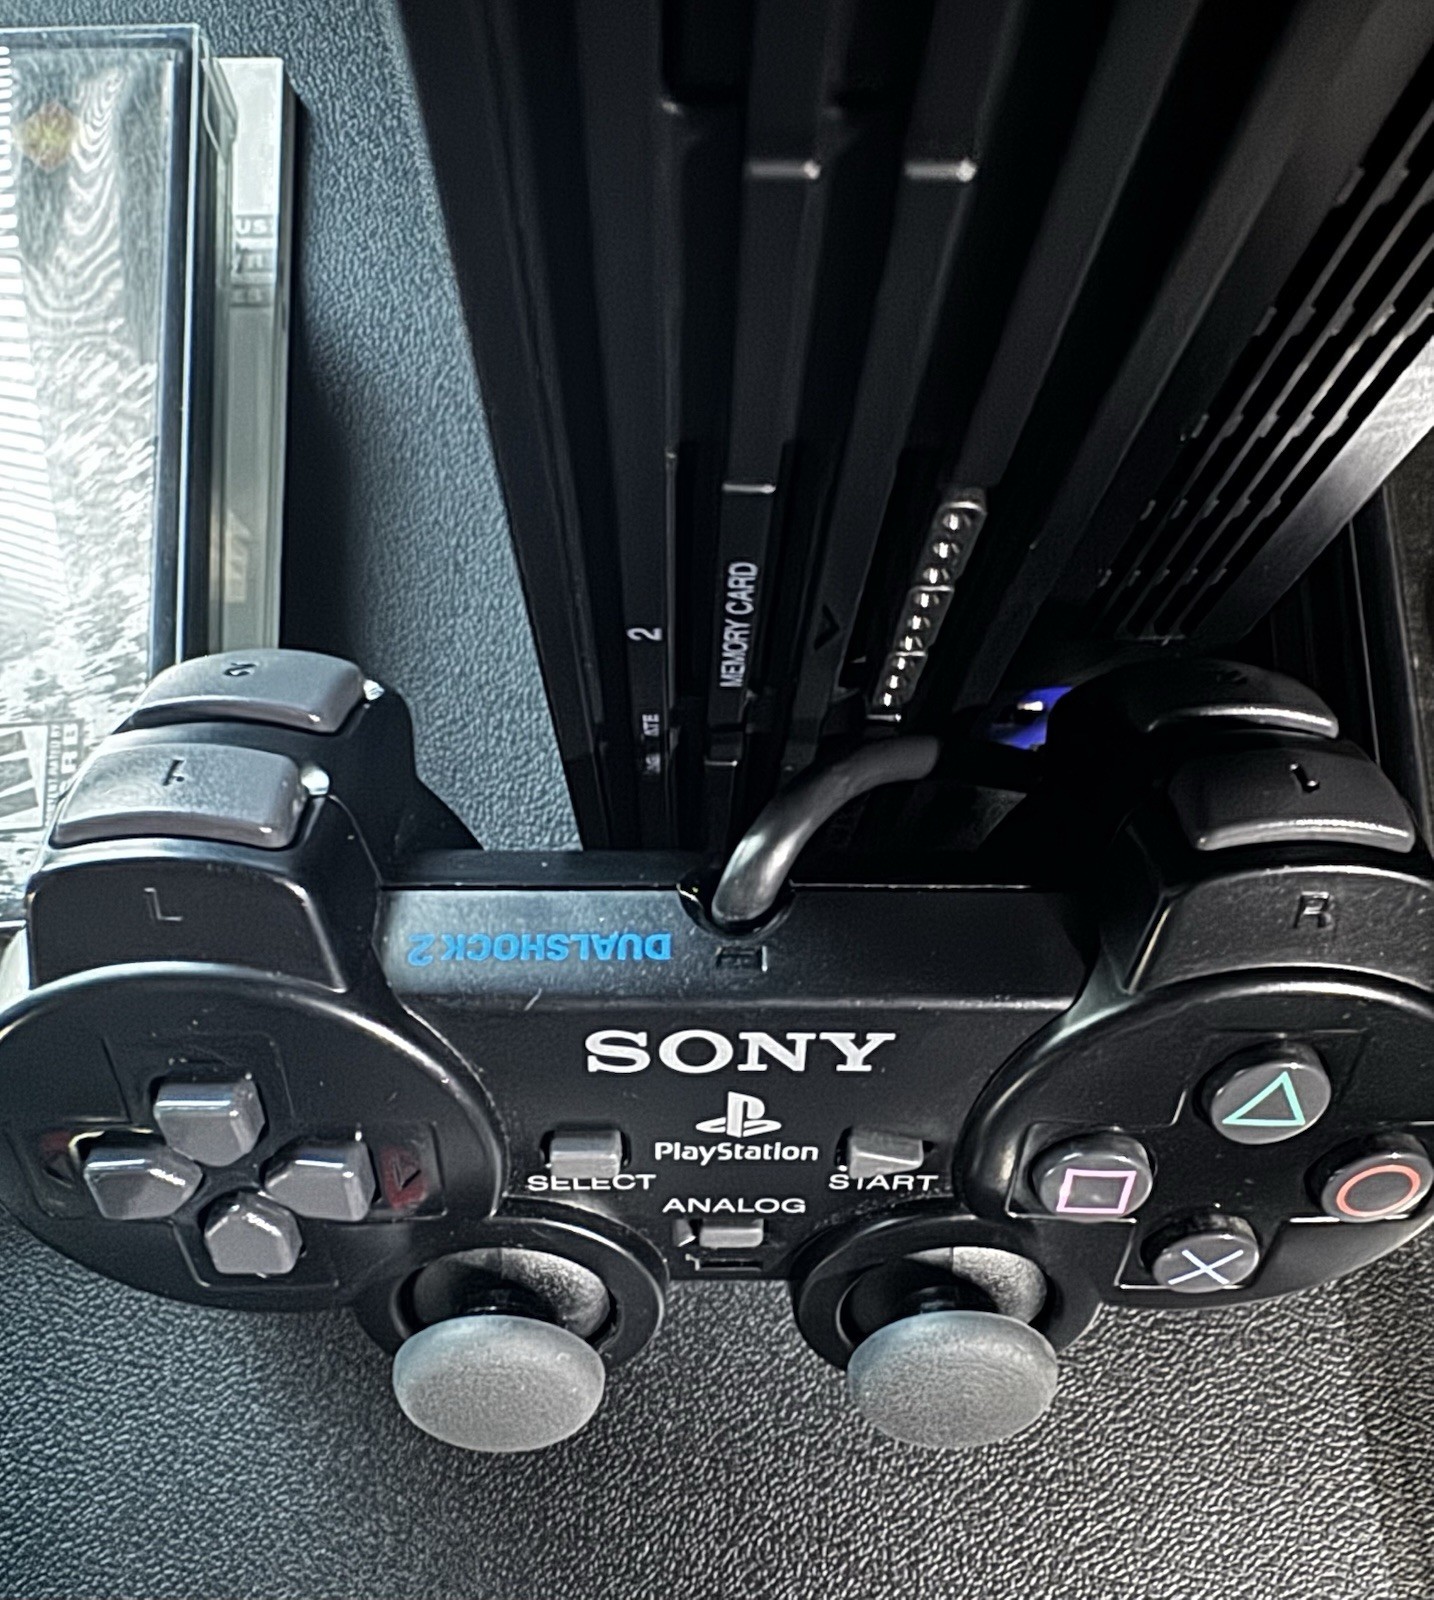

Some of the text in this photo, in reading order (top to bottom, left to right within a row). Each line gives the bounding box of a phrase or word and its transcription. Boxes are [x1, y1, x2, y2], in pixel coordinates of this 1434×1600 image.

[627, 627, 662, 642] 2
[720, 561, 759, 688] MEMORY CARD
[142, 887, 183, 923] L
[1292, 890, 1332, 930] R
[408, 932, 673, 967] DUALSHOCK 2
[584, 1029, 897, 1075] SONY
[654, 1141, 819, 1166] PlayStation
[527, 1173, 656, 1192] SELECT
[662, 1196, 807, 1214] ANALOG
